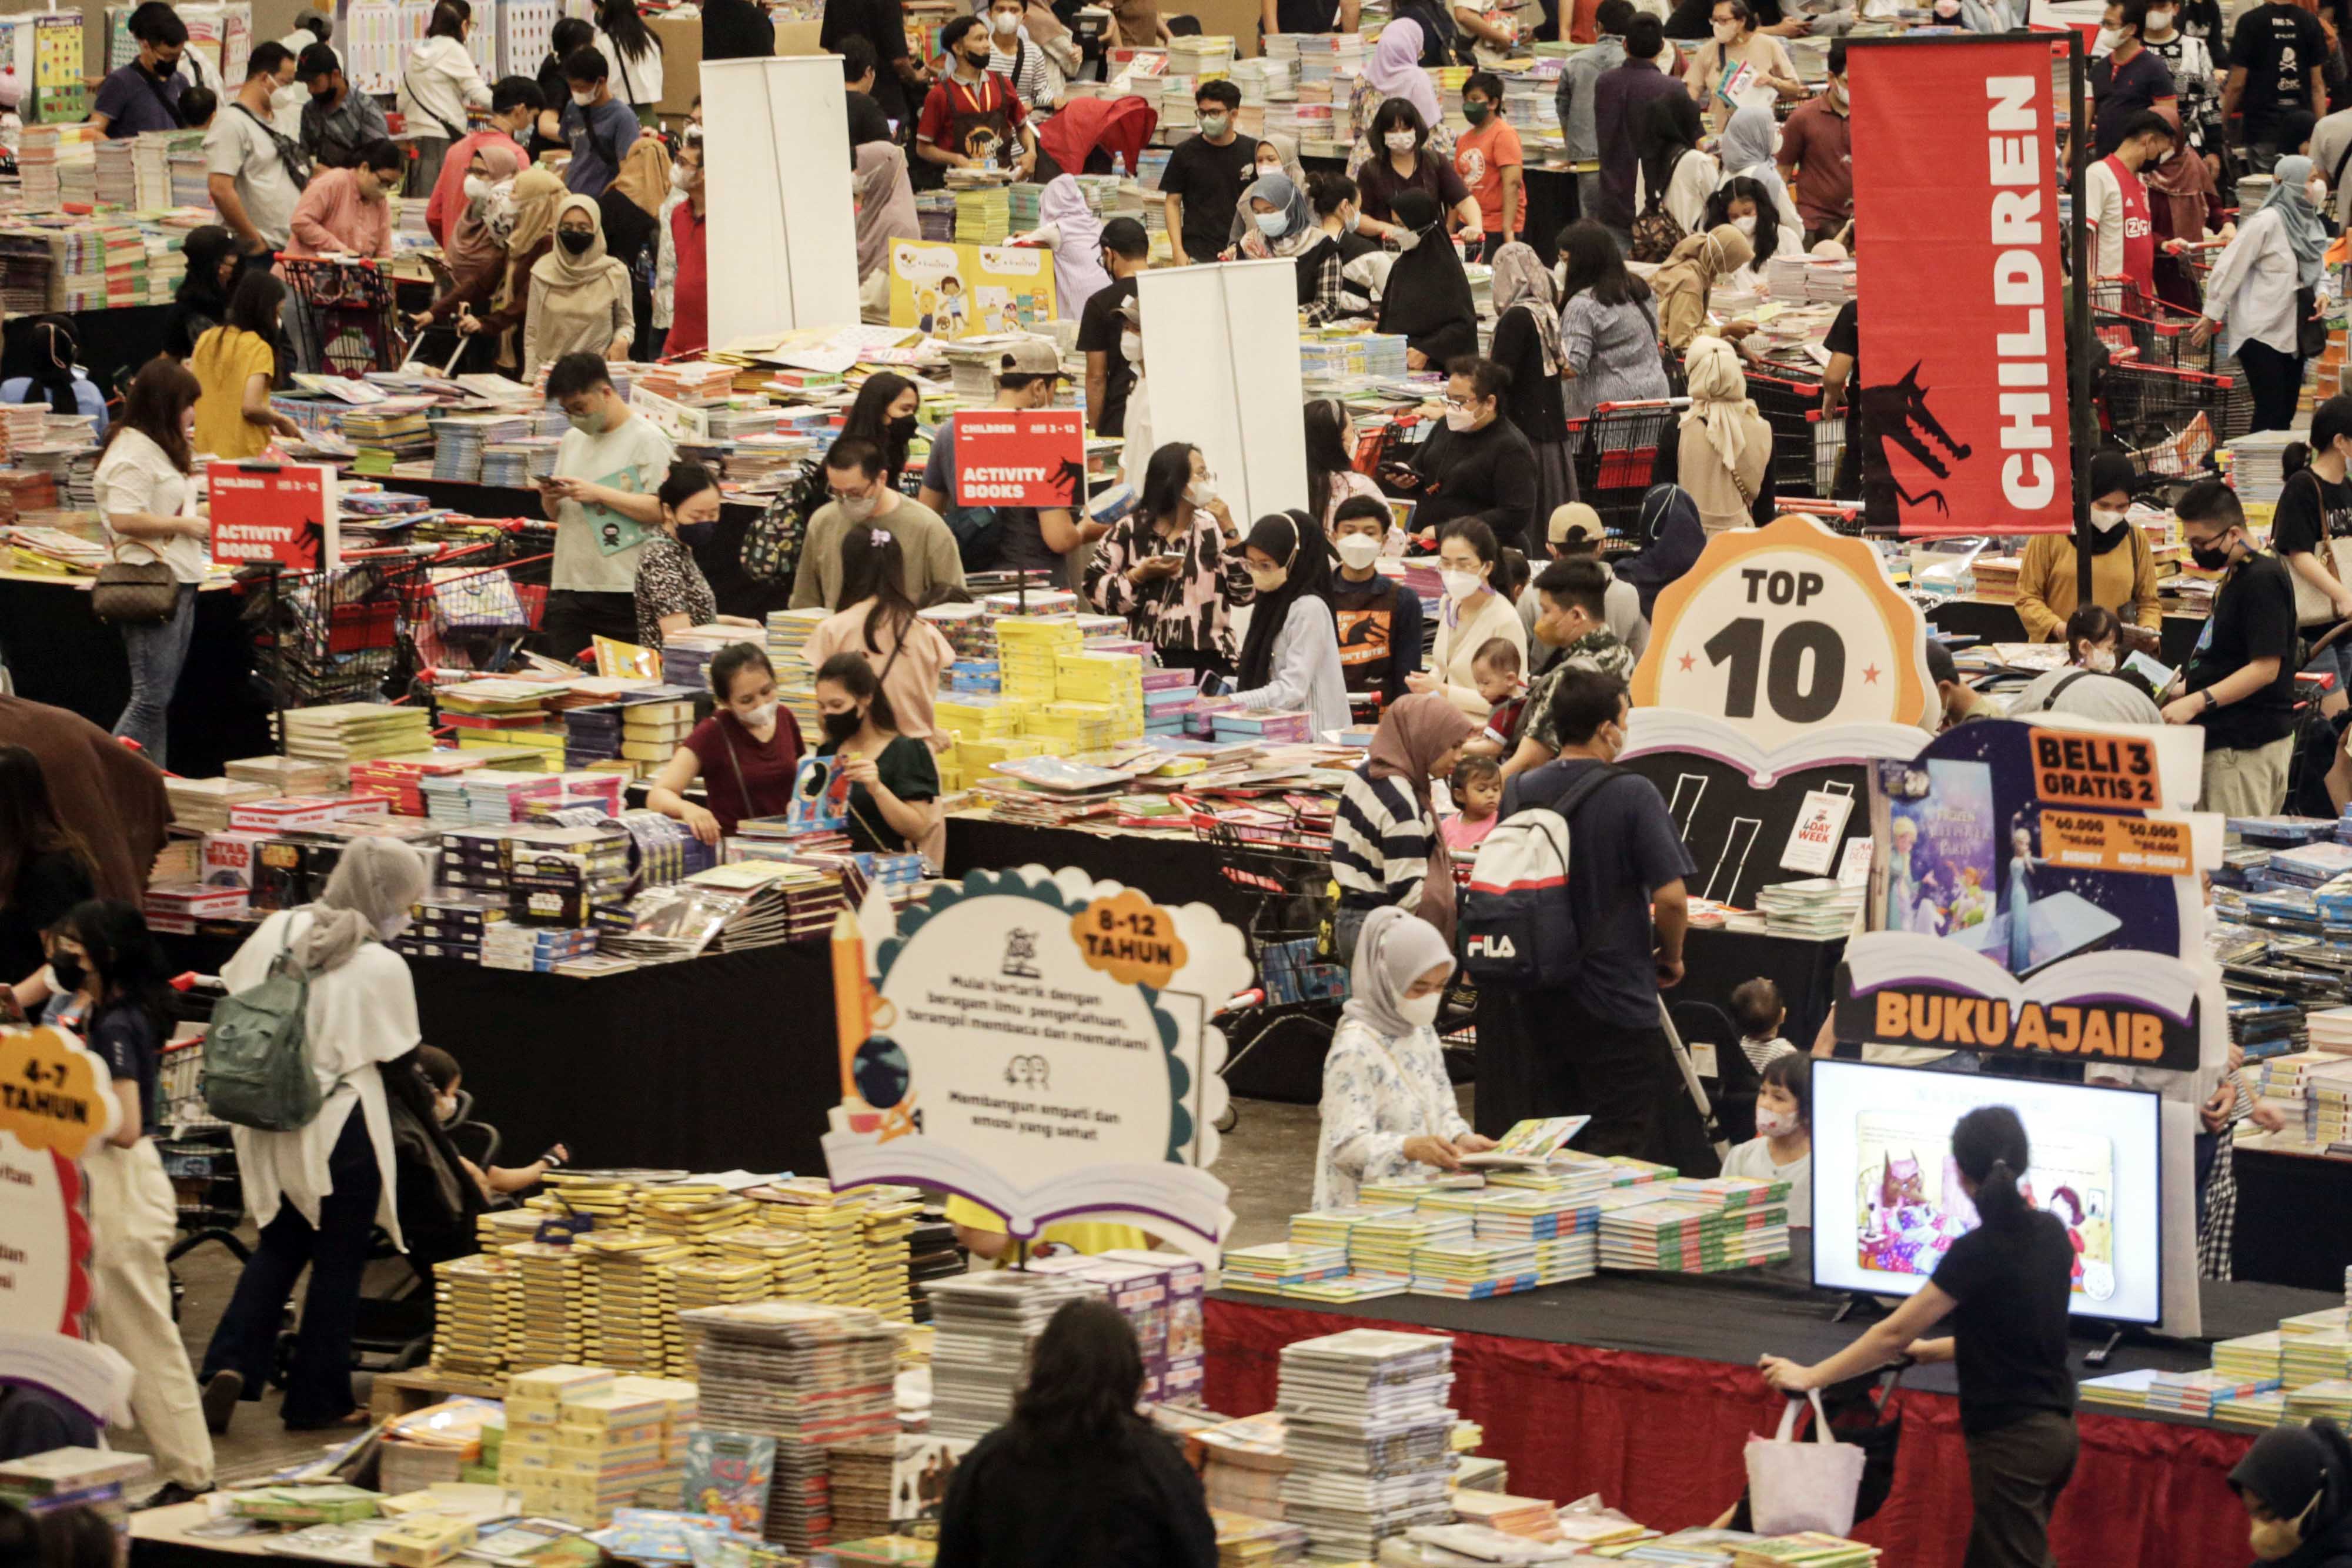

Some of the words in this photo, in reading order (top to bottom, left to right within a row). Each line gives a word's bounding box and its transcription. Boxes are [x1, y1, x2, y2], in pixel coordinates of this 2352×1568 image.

[1986, 75, 2055, 510] CHILDREN
[960, 423, 1016, 434] CHILDREN
[963, 467, 1047, 482] ACTIVITY
[963, 484, 1025, 499] BOOKS
[216, 523, 293, 543] ACTIVITY
[216, 541, 274, 559] BOOKS
[1741, 568, 1824, 607] TOP
[1703, 617, 1846, 724] 10
[2037, 737, 2119, 774] BELI
[2127, 743, 2151, 775] 3
[2043, 773, 2133, 801] GRATIS
[2137, 781, 2154, 802] 2
[206, 841, 247, 855] STAR
[1798, 830, 1830, 844] WEEK
[207, 854, 249, 868] WARS
[1099, 910, 1155, 936] 8-12
[1085, 933, 1171, 965] TAHUN
[1467, 935, 1516, 957] FILA
[1050, 988, 1101, 1007] dengan
[971, 1018, 1038, 1037] membaca
[1044, 1027, 1068, 1040] dan
[1073, 1031, 1150, 1052] memahami
[1875, 991, 2009, 1047] BUKU
[2013, 1001, 2163, 1061] AJAIB
[24, 1058, 69, 1088] 4-7
[1, 1083, 88, 1124] TAHUN
[948, 1091, 1035, 1114] Membangun
[1094, 1111, 1121, 1124] dan
[1019, 1121, 1053, 1138] yang
